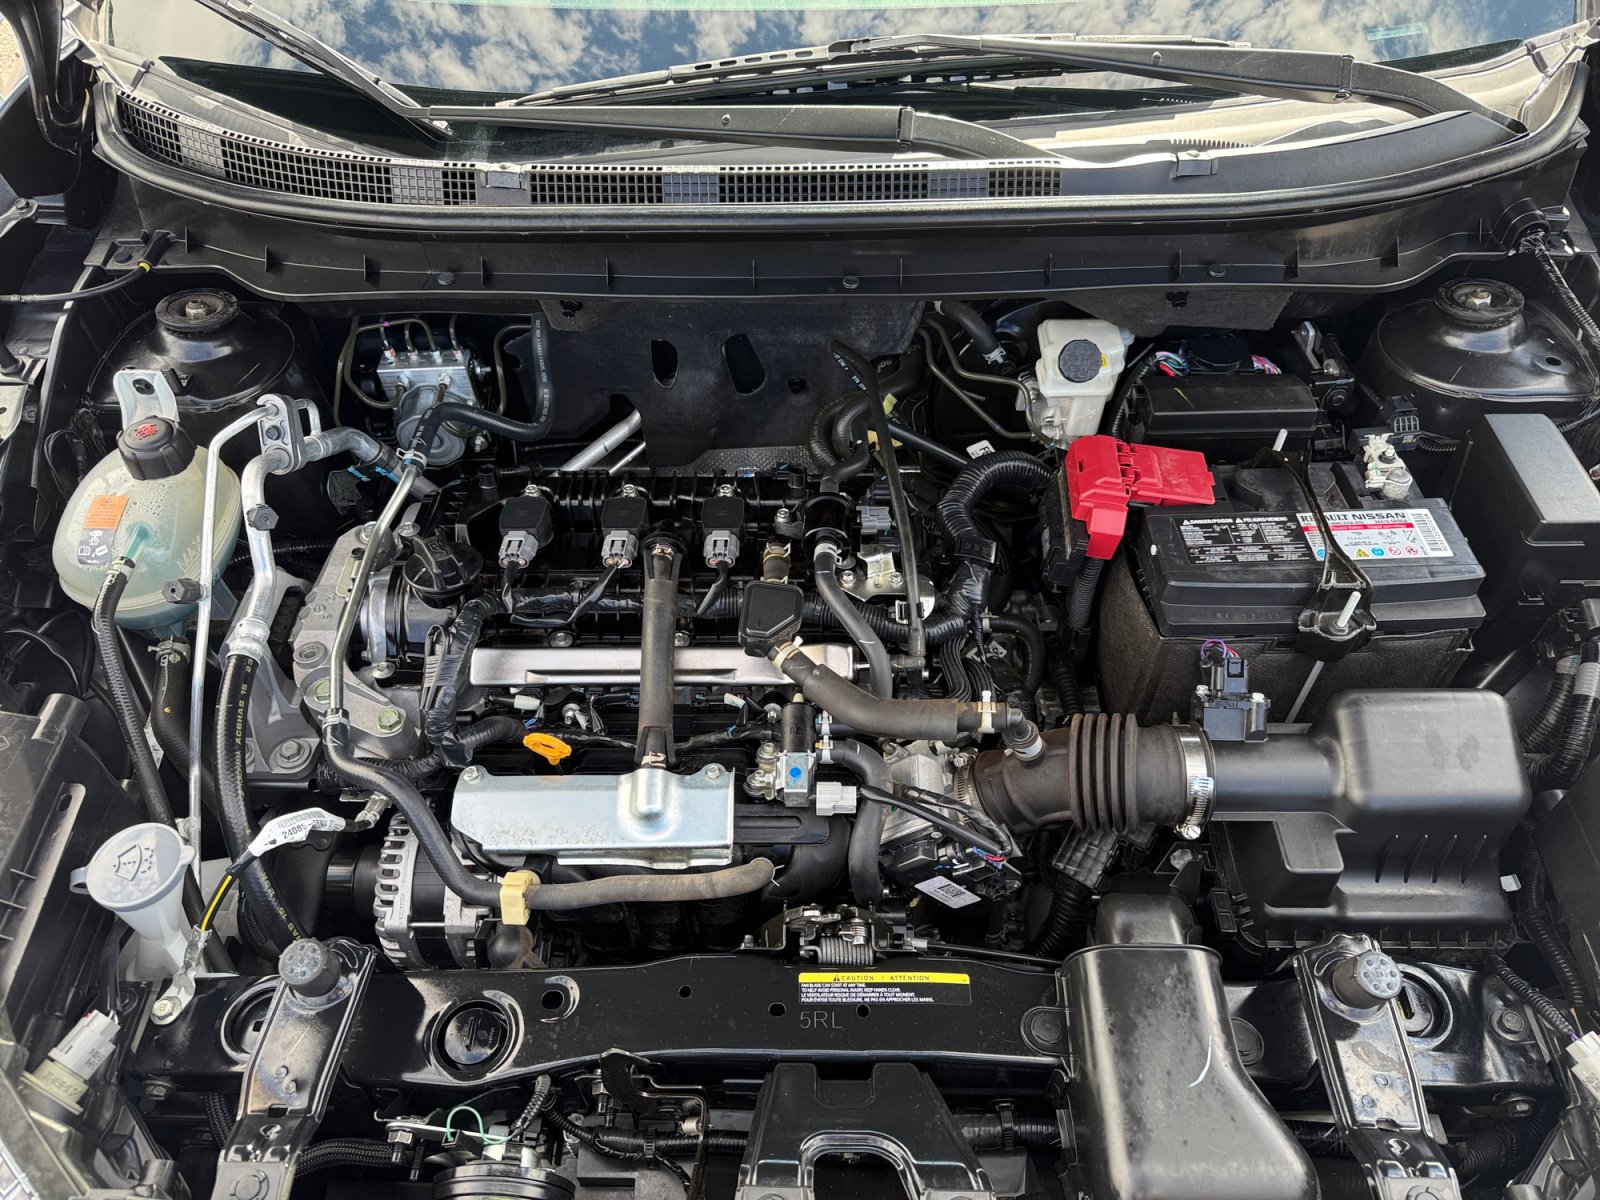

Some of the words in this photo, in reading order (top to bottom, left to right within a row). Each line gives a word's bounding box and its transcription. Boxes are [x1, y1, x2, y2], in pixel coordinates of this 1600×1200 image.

[1352, 512, 1406, 520] NISSAN
[240, 684, 248, 696] 15
[800, 1011, 843, 1028] 5RL
